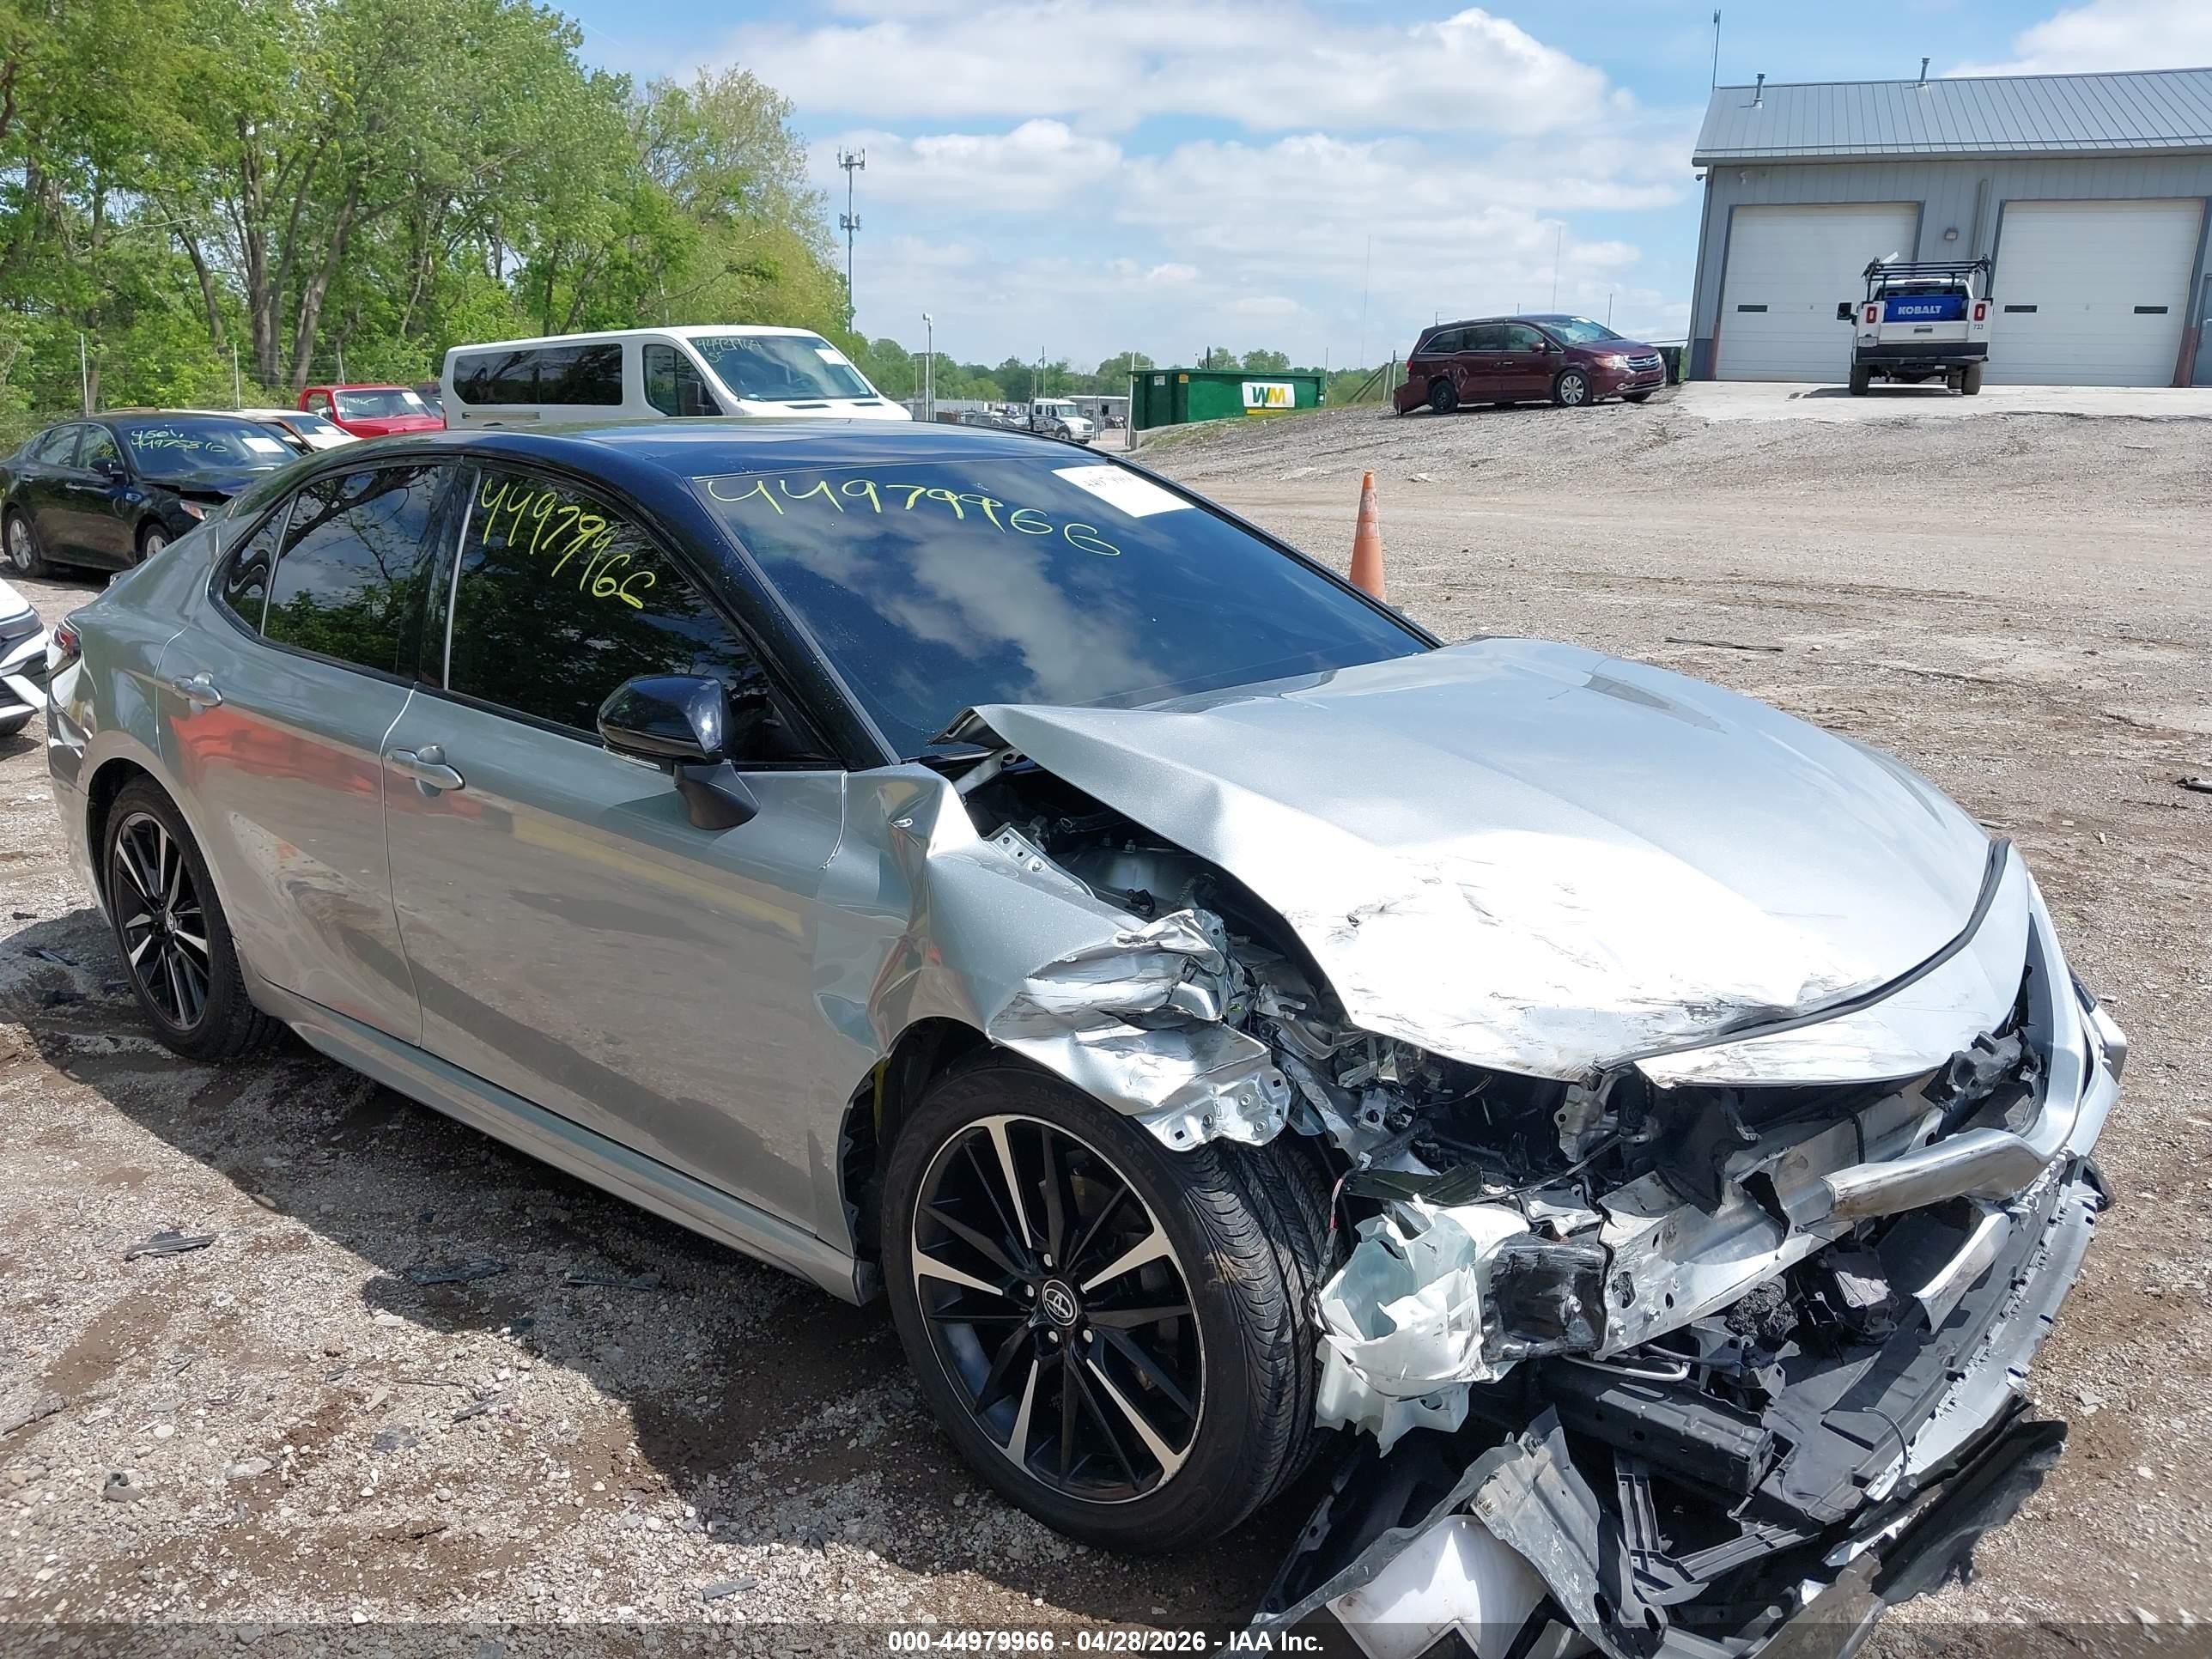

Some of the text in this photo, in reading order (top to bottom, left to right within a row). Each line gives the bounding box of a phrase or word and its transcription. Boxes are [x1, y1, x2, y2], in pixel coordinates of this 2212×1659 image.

[1898, 305, 1942, 315] KOBALT
[1252, 386, 1286, 404] WM
[708, 479, 1120, 556] 44979966
[481, 477, 655, 610] 44979966
